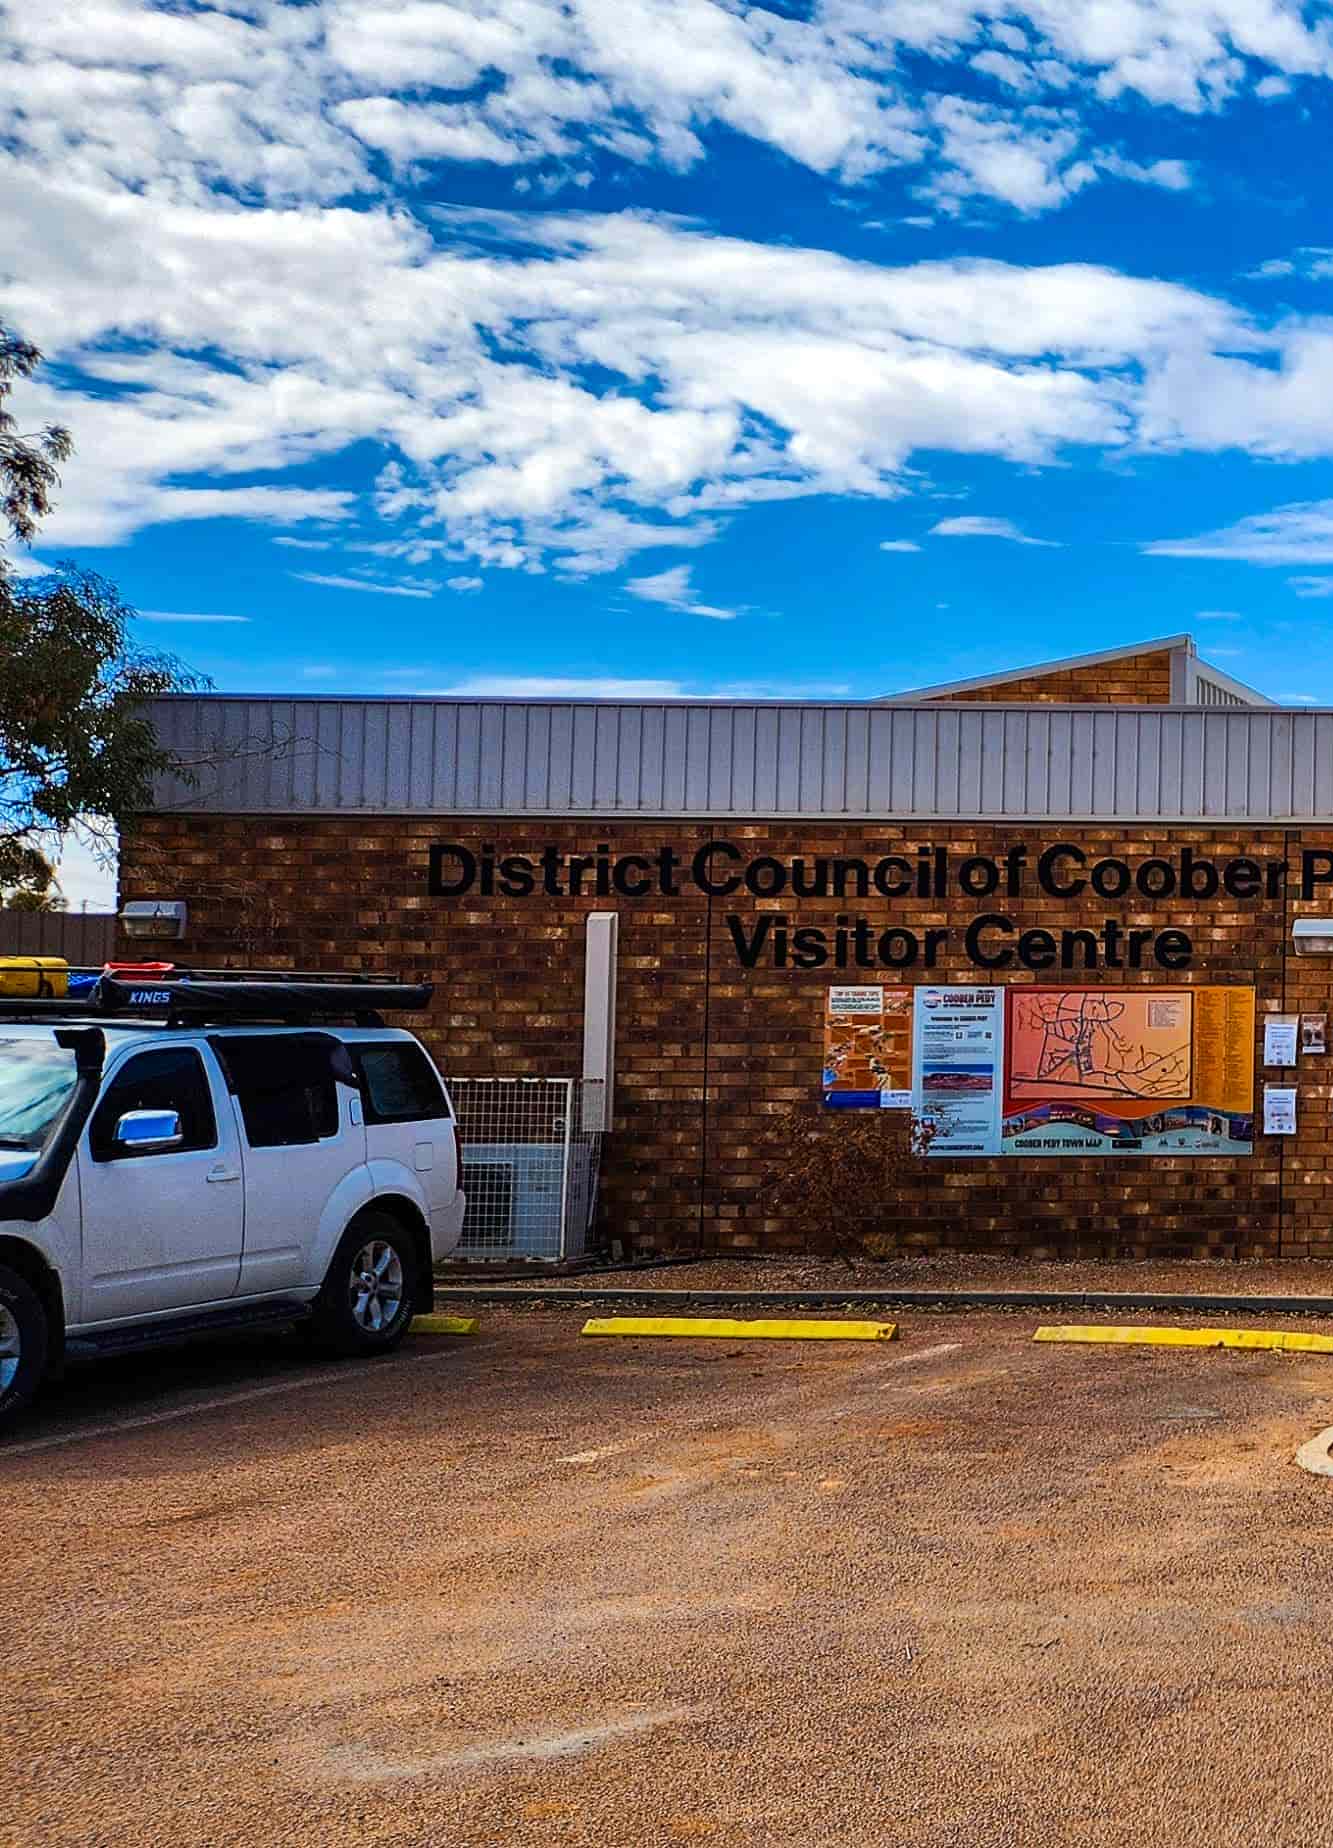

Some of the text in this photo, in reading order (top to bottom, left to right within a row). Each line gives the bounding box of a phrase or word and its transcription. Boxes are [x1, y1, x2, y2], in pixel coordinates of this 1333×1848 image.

[427, 843, 680, 898] District
[693, 840, 948, 899] Council
[958, 844, 1027, 899] of
[1038, 843, 1289, 901] Coober
[726, 912, 1193, 970] Visitor Centre
[129, 991, 171, 1004] KINGS
[1062, 1139, 1084, 1148] TOWN
